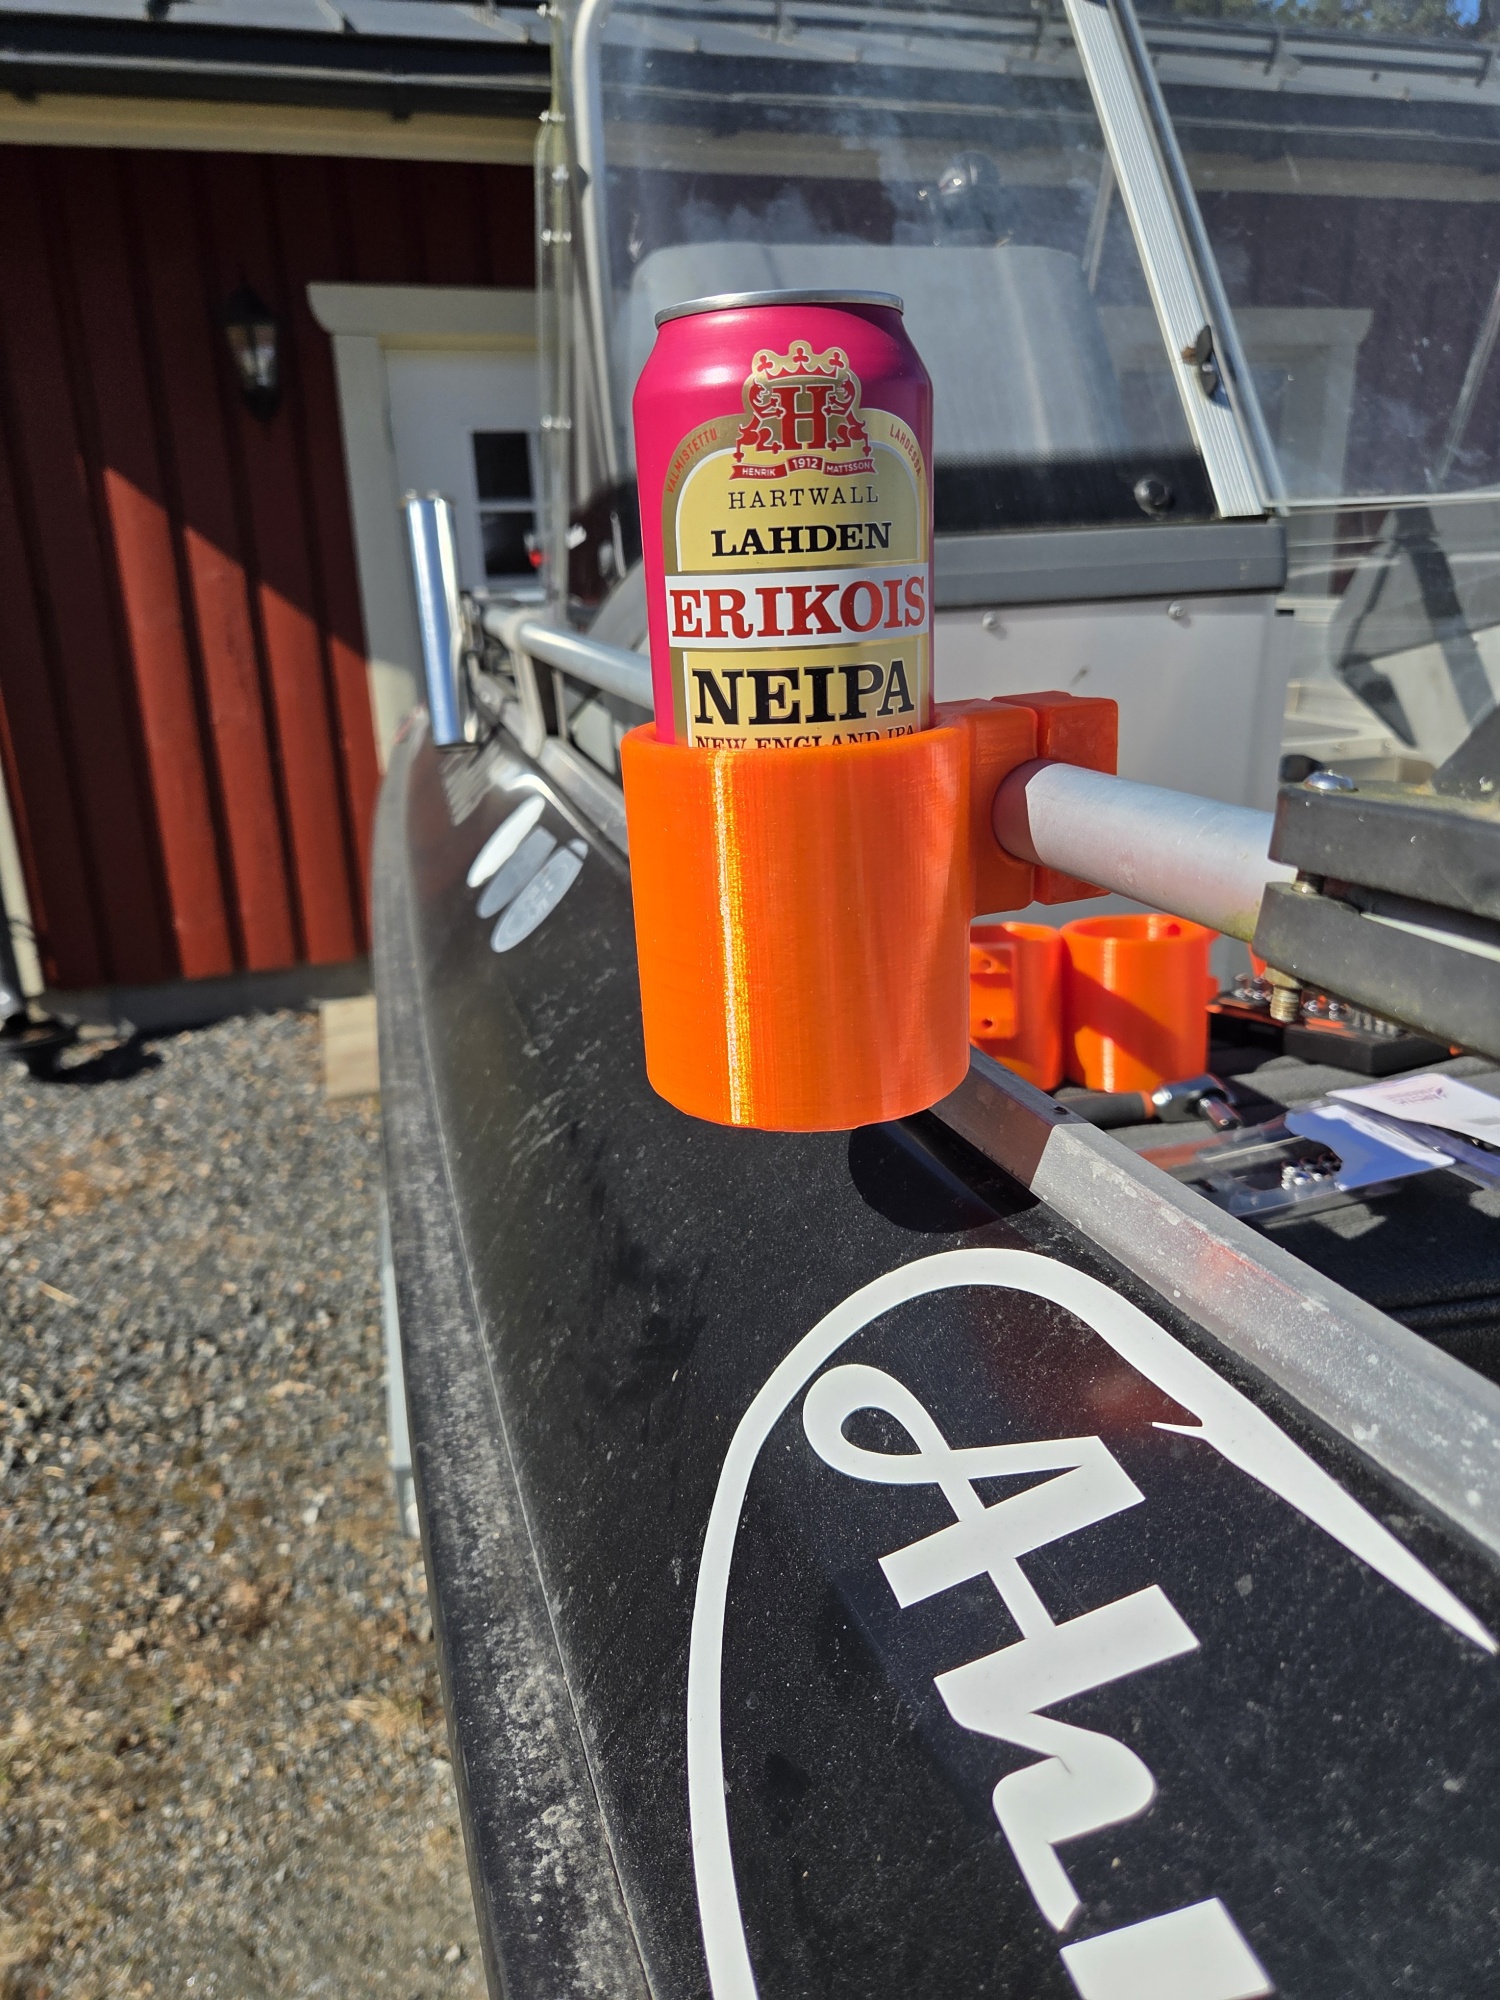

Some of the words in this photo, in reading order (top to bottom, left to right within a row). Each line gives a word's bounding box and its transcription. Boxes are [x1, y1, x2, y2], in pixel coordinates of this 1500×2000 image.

[771, 385, 835, 451] H
[666, 427, 718, 494] VALMISTETTU
[889, 423, 922, 477] LAHDESSA
[742, 467, 776, 477] HENRIK
[792, 458, 819, 470] 1912
[826, 461, 871, 473] MATTSSON
[728, 486, 879, 510] HARTWALL
[710, 522, 892, 557] LAHDEN
[669, 575, 926, 639] ERIKOIS
[692, 660, 915, 726] NEIPA
